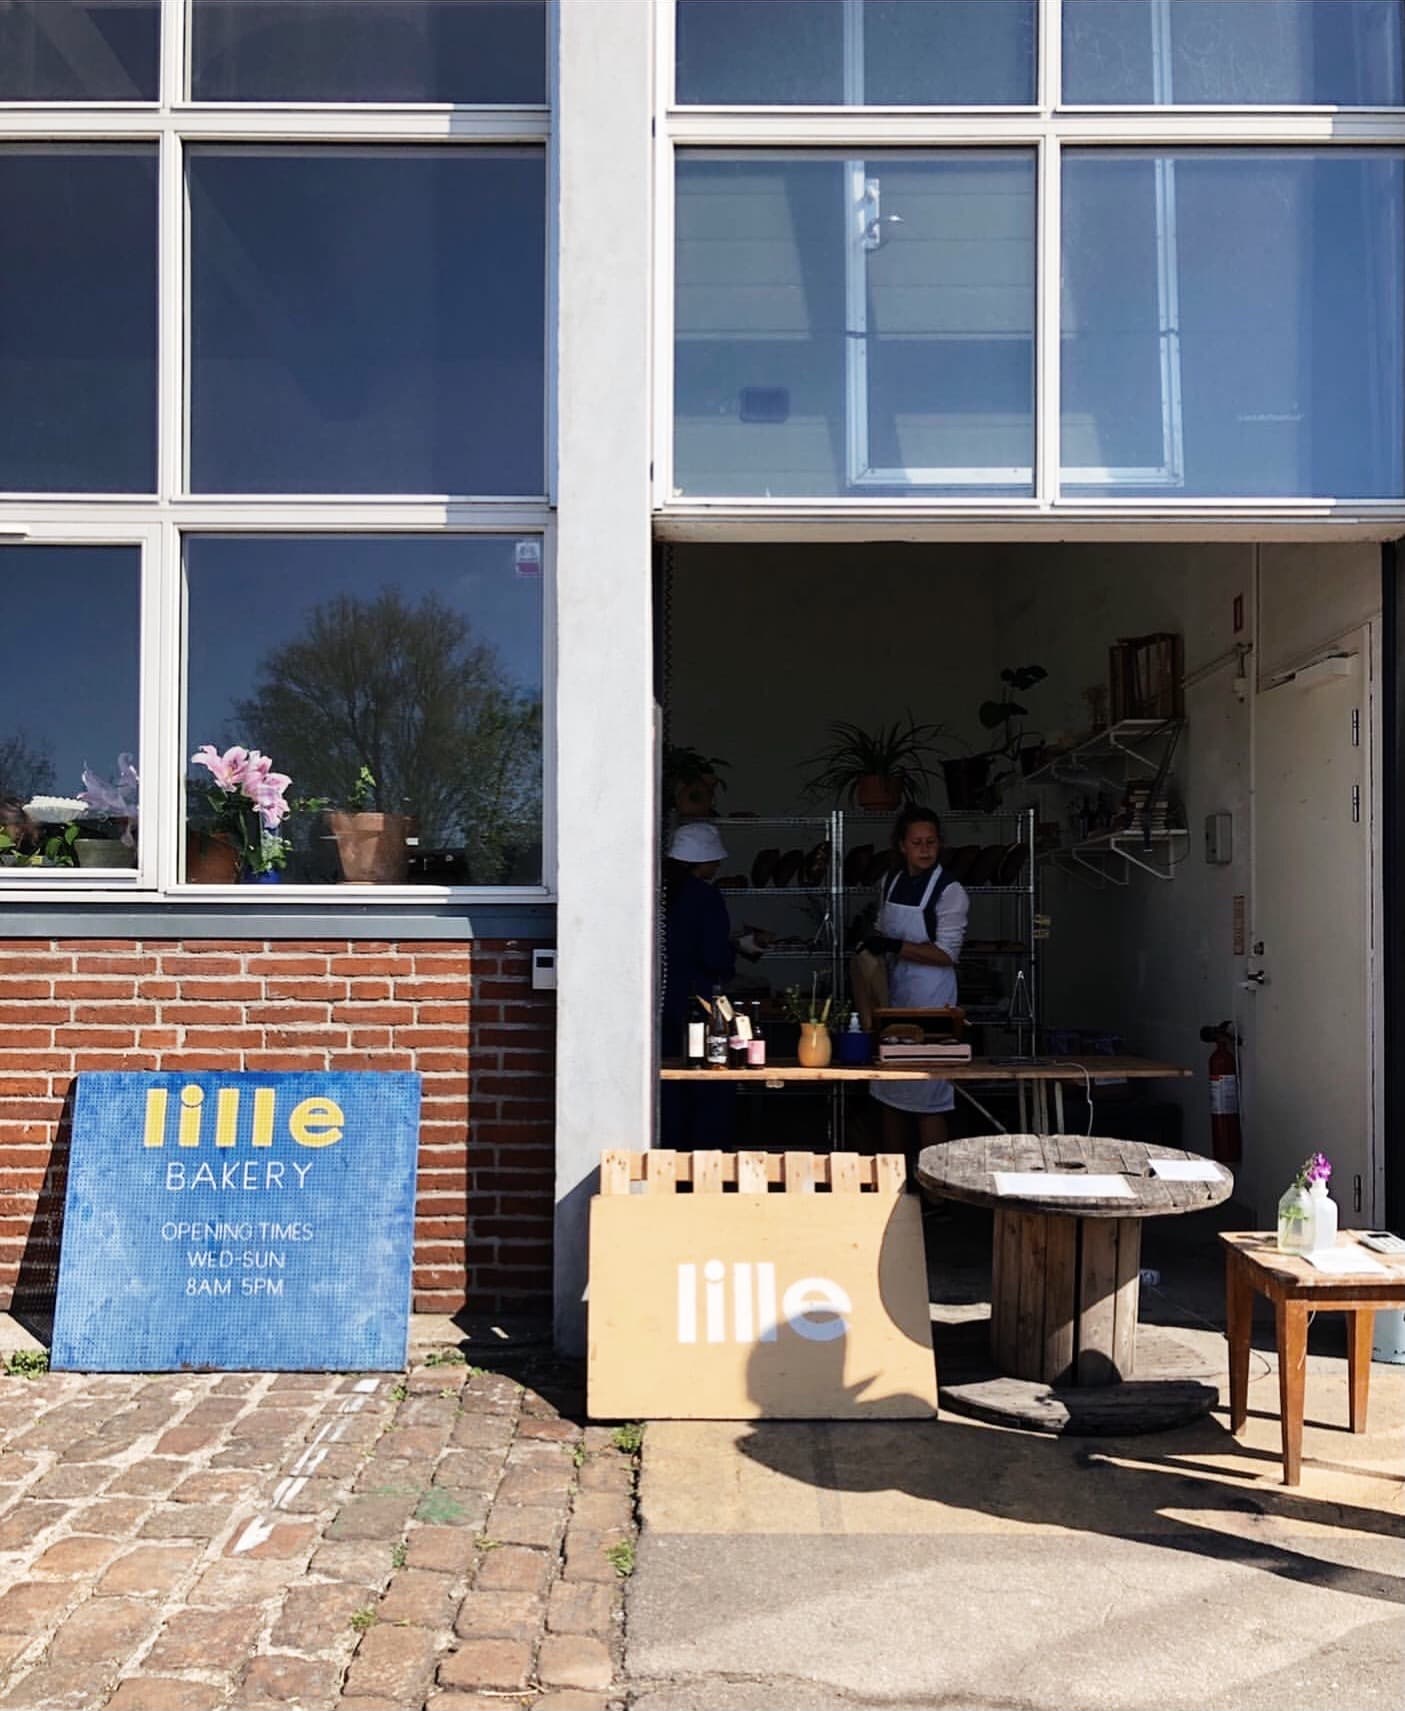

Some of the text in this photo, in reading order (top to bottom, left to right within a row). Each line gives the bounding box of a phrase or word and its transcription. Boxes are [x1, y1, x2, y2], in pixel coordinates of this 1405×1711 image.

[143, 1084, 345, 1148] lille
[165, 1161, 314, 1191] BAKERY
[161, 1222, 314, 1241] OPENING TIMES
[187, 1250, 286, 1269] WED-SUN
[185, 1277, 284, 1297] 8AM 5PM
[677, 1259, 852, 1344] lille
